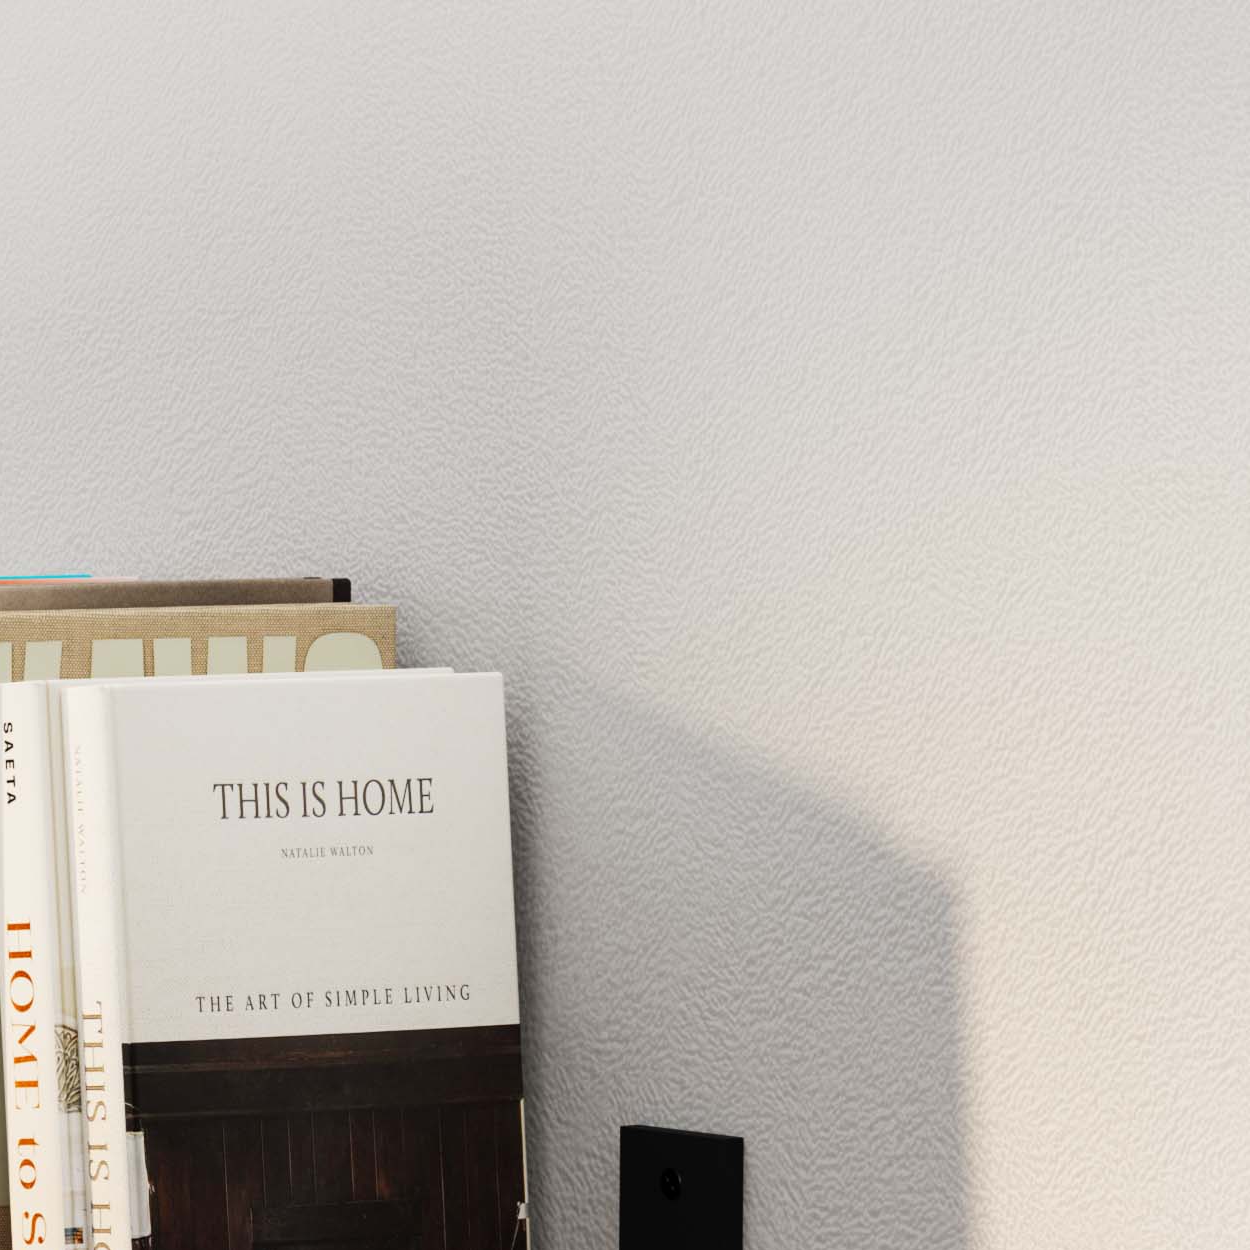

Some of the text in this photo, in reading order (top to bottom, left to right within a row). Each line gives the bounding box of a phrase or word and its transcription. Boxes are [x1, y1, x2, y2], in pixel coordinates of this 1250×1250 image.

[3, 722, 17, 805] SAETA
[213, 778, 434, 819] THIS IS HOME
[281, 846, 374, 858] NATALIE WALTON
[6, 921, 41, 1110] HOME
[195, 984, 471, 1013] THE ART OF SIMPLE LIVING
[82, 1000, 108, 1122] THIS
[17, 1137, 38, 1190] to
[87, 1140, 110, 1181] IS
